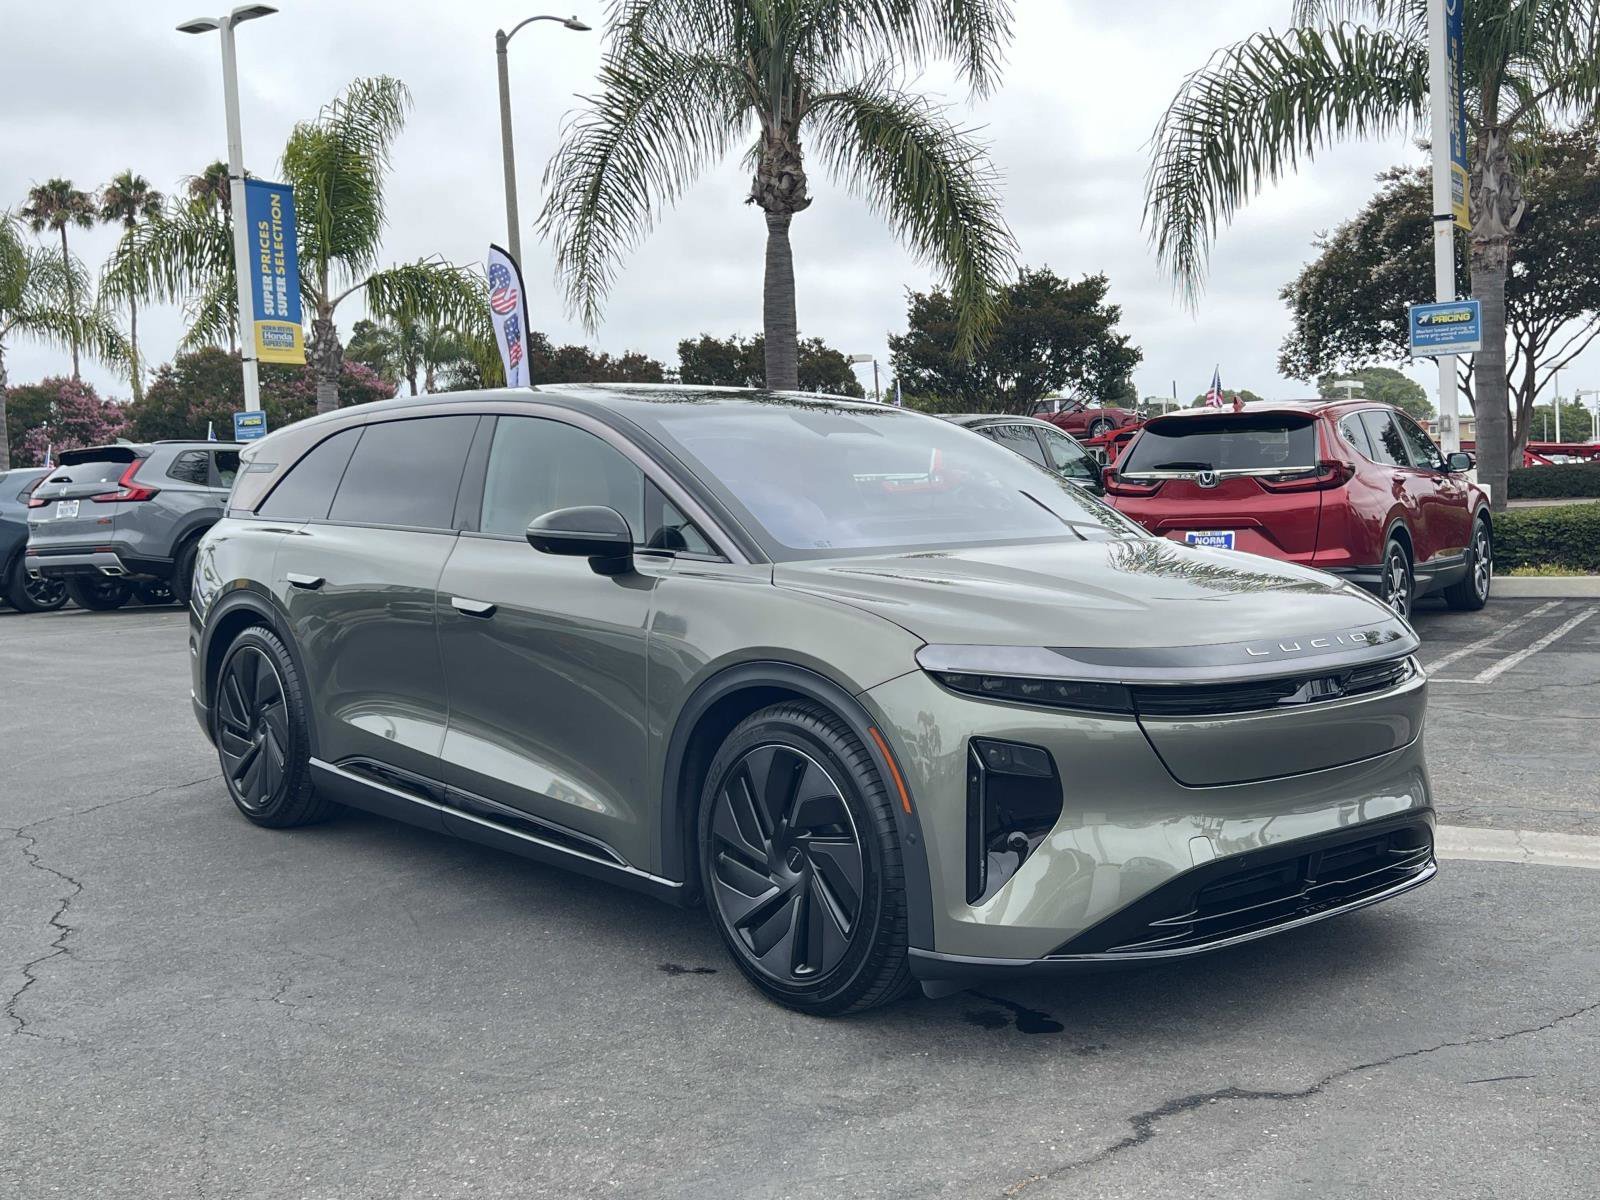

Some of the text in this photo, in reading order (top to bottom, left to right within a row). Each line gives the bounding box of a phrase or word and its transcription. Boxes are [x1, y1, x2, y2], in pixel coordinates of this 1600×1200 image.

[1452, 38, 1461, 157] EXPERIENCE
[270, 193, 288, 317] SUPER SELECTION
[258, 221, 274, 316] SUPER PRICES
[1432, 313, 1470, 324] PRICING
[263, 331, 292, 340] Honda
[263, 340, 294, 348] SUPERSTORE
[1194, 536, 1225, 545] NORM
[1246, 633, 1366, 656] LUCID
